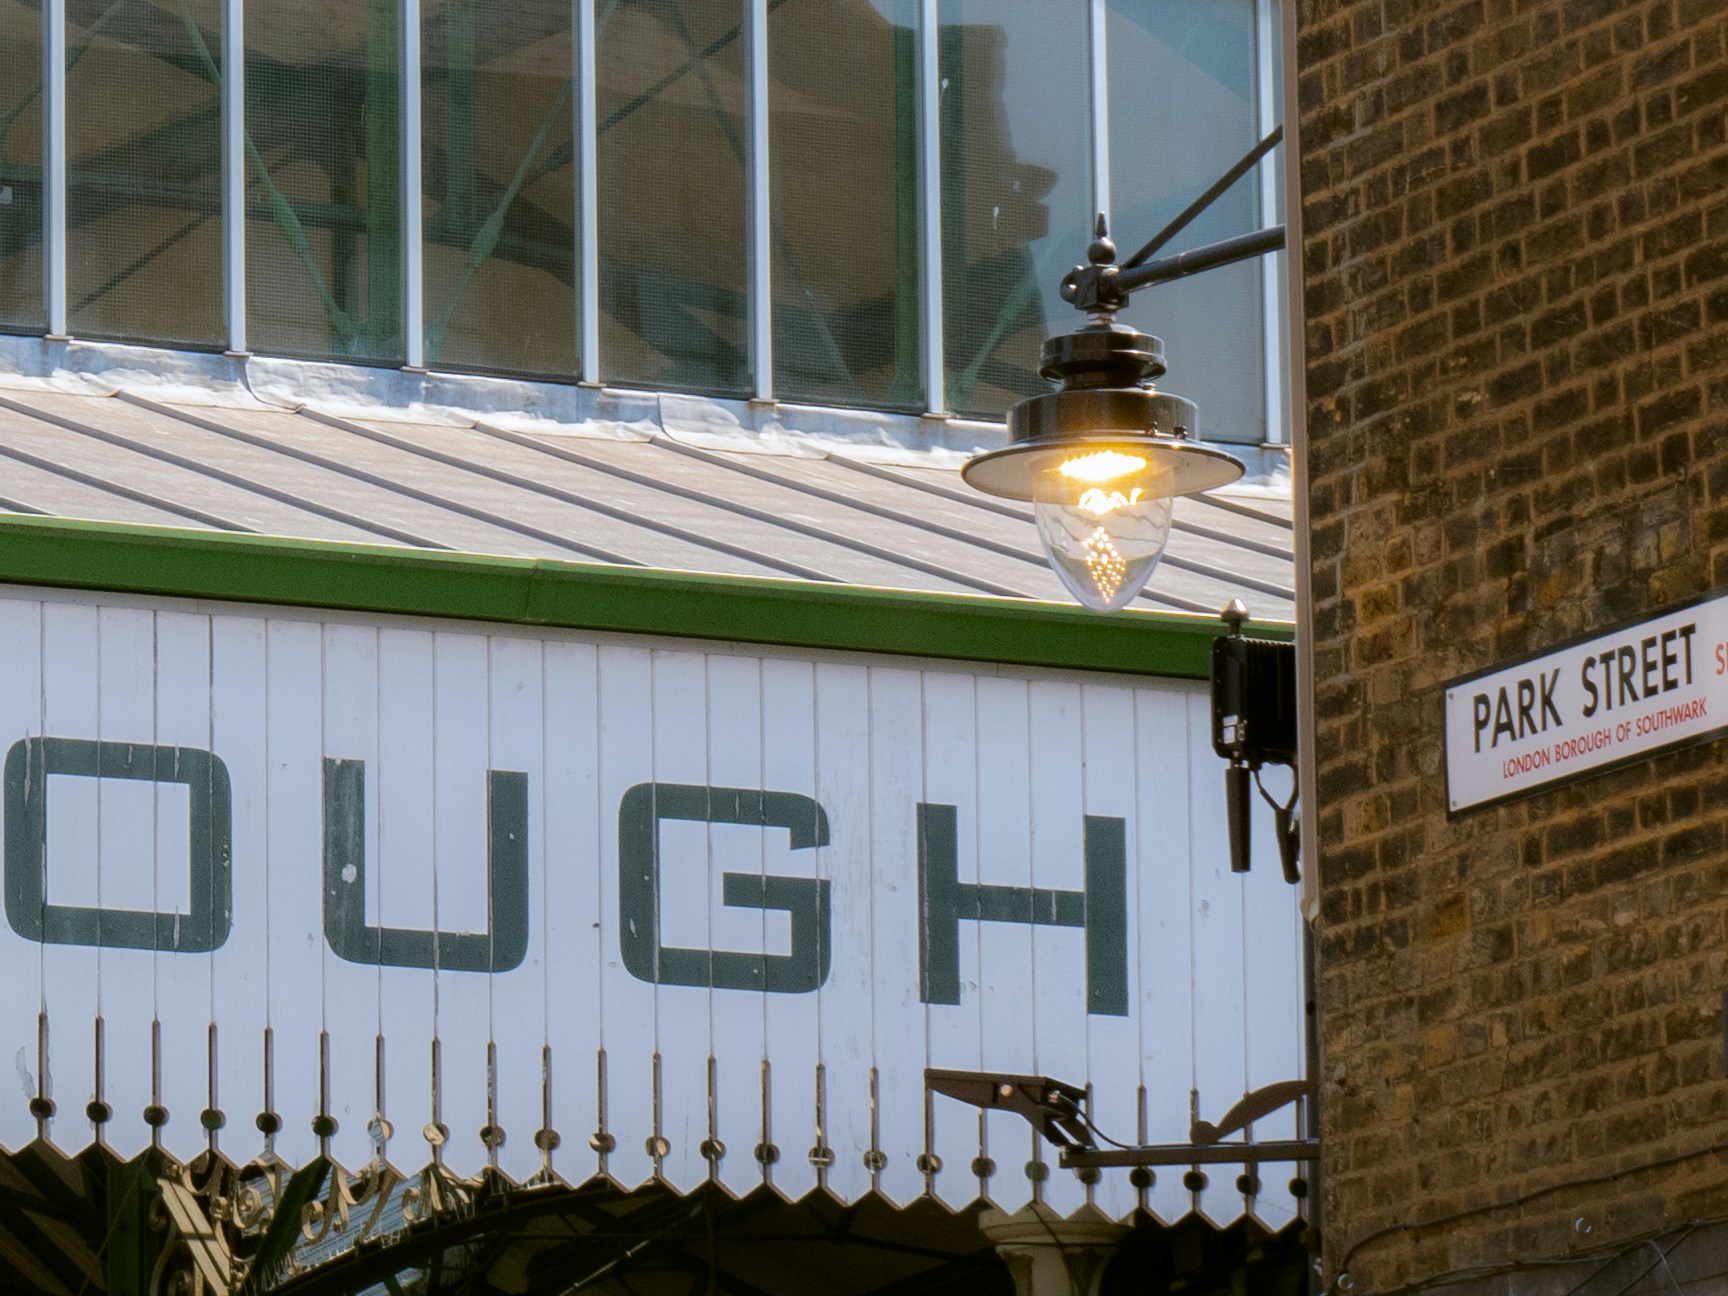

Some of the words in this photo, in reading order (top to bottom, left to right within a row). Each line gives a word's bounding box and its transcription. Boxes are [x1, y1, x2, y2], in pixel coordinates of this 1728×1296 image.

[1473, 668, 1563, 754] PARK
[1581, 623, 1697, 718] STREET
[1715, 642, 1728, 675] S
[1503, 747, 1551, 779] LONDON
[1555, 728, 1611, 763] BOROUGH
[1616, 722, 1632, 743] OF
[1636, 697, 1708, 737] SOUTHWARK
